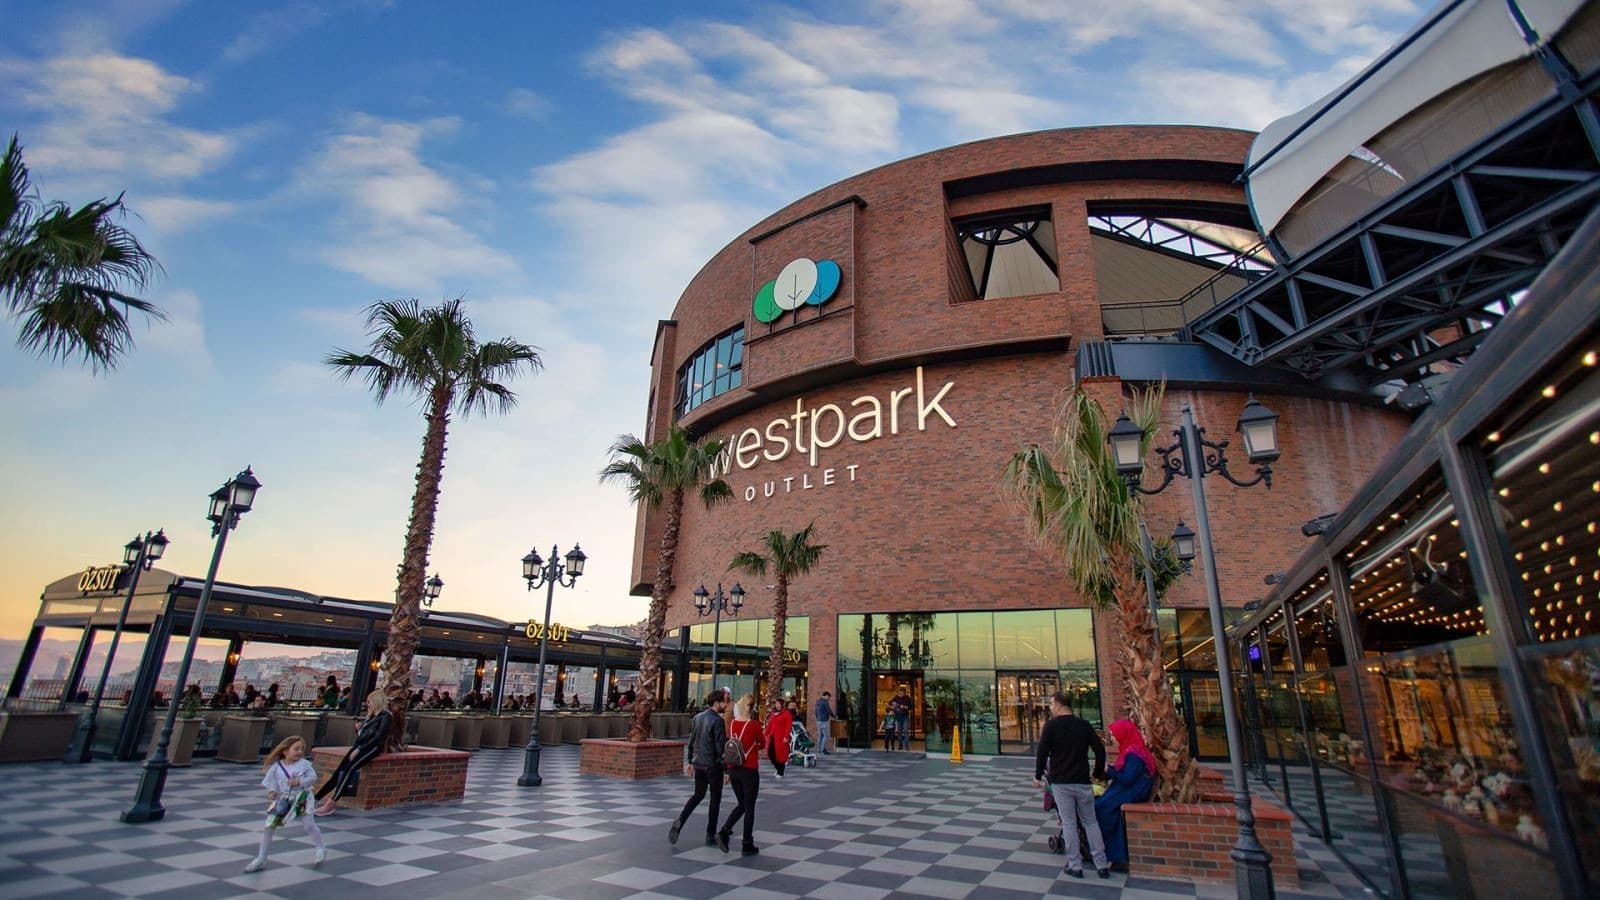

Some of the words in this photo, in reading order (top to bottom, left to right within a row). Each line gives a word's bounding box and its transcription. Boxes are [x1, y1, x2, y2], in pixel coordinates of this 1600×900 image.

[709, 366, 957, 479] westpark
[745, 464, 859, 501] OUTLET
[78, 564, 121, 592] ÖZSÜT
